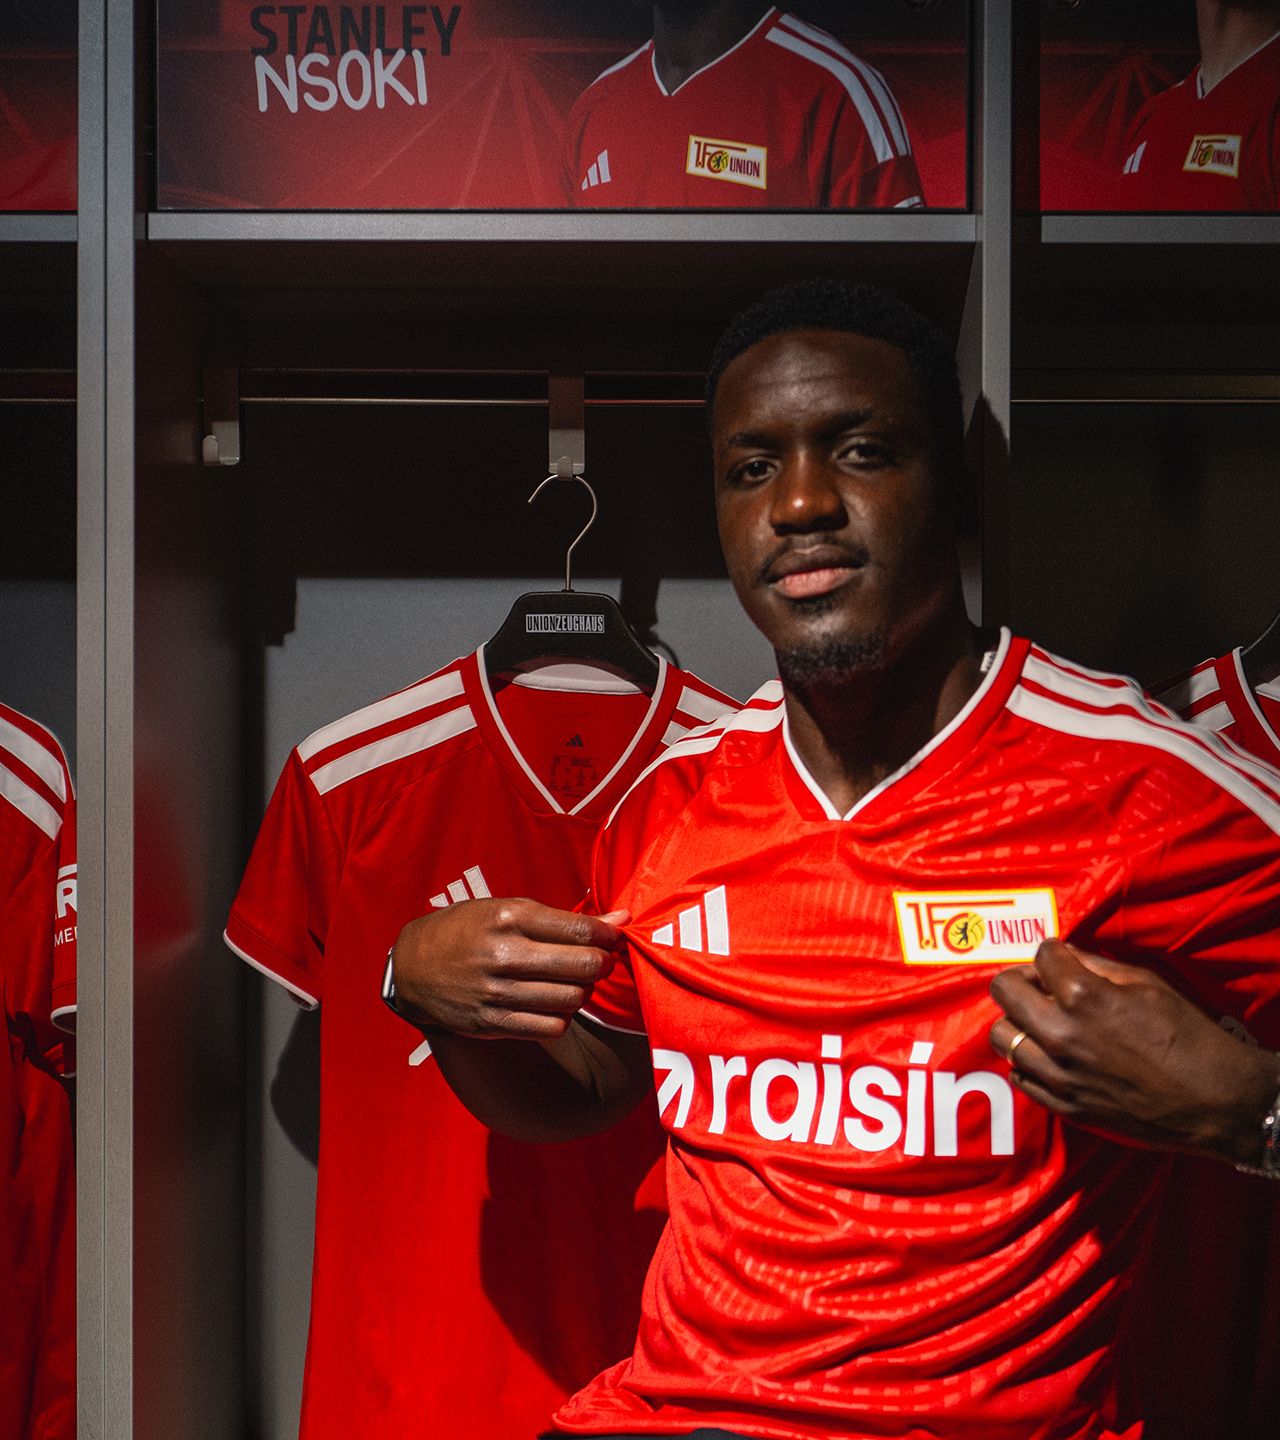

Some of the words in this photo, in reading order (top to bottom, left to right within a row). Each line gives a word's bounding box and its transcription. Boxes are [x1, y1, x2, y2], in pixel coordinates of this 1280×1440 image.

[250, 5, 462, 55] STANLEY
[254, 48, 428, 113] NSOKI
[729, 157, 761, 178] UNION
[988, 918, 1047, 945] UNION
[708, 1034, 1015, 1157] raisin
